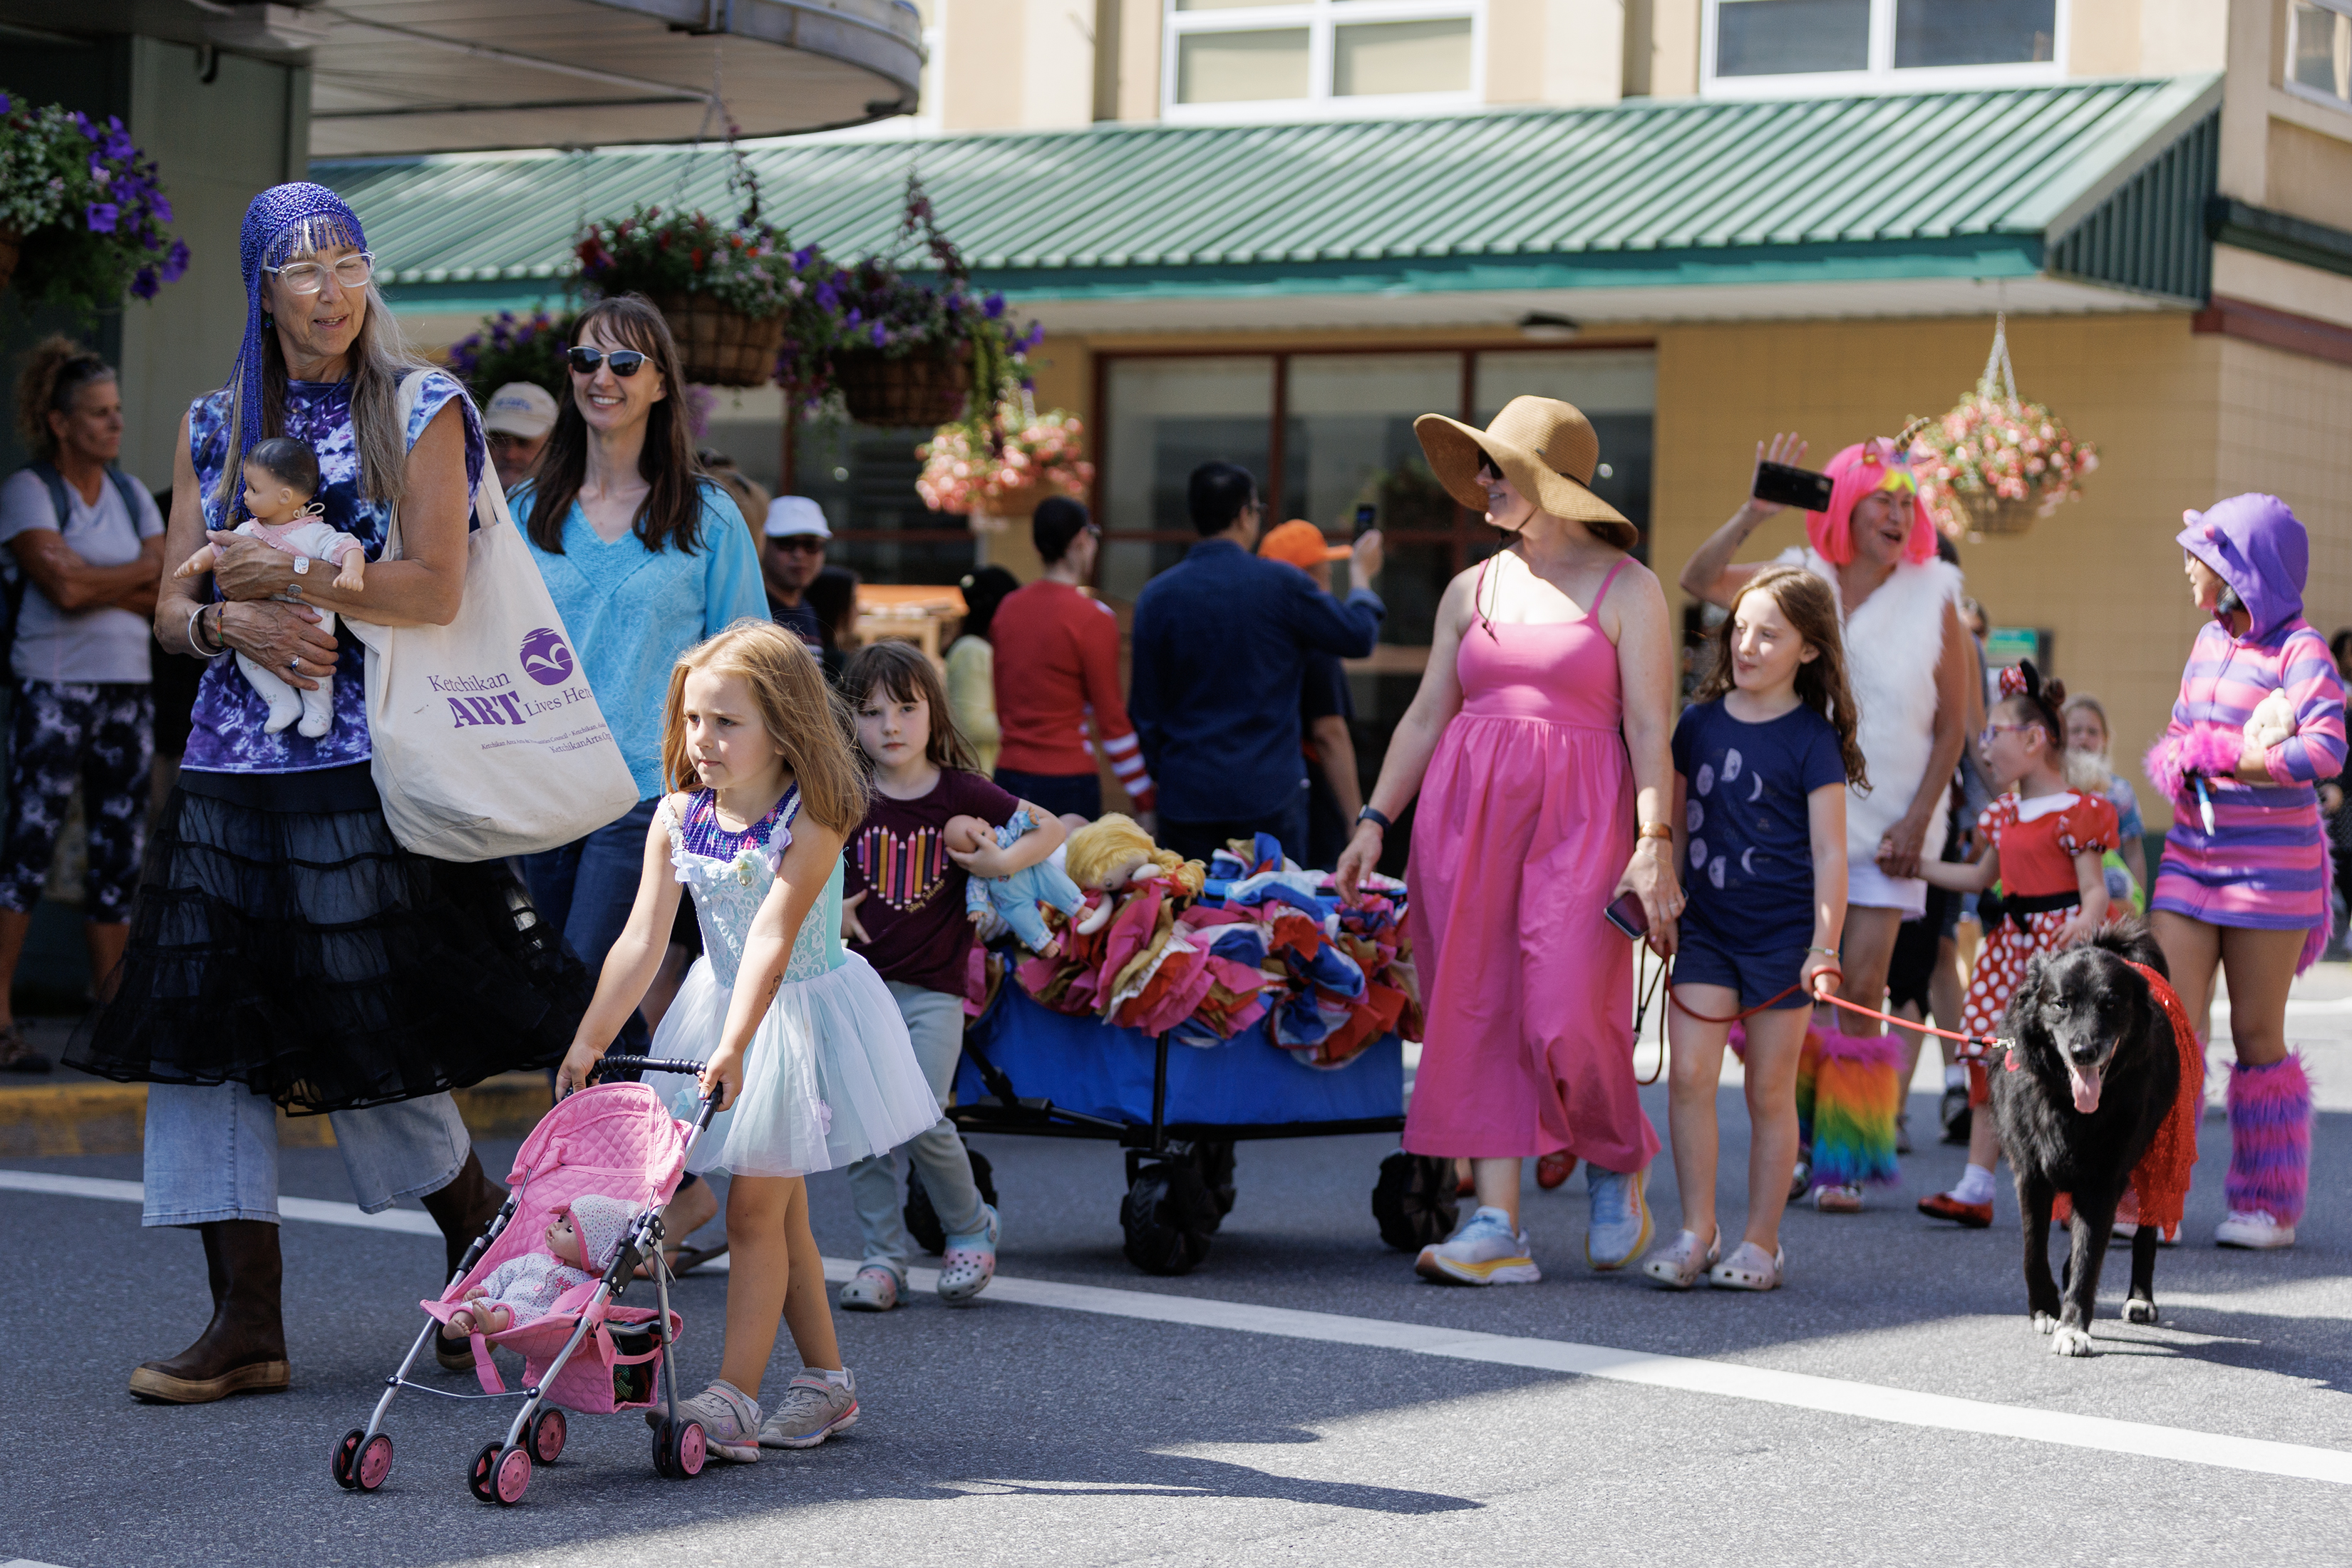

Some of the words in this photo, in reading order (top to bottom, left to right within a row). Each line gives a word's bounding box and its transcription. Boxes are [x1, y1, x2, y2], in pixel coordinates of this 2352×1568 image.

[426, 673, 512, 692] Ketchikan
[446, 690, 527, 728] ART
[523, 698, 562, 717] Lives
[480, 741, 506, 750] Ketchikan
[550, 732, 569, 743] Council
[548, 731, 612, 753] KetchikanArts.Org
